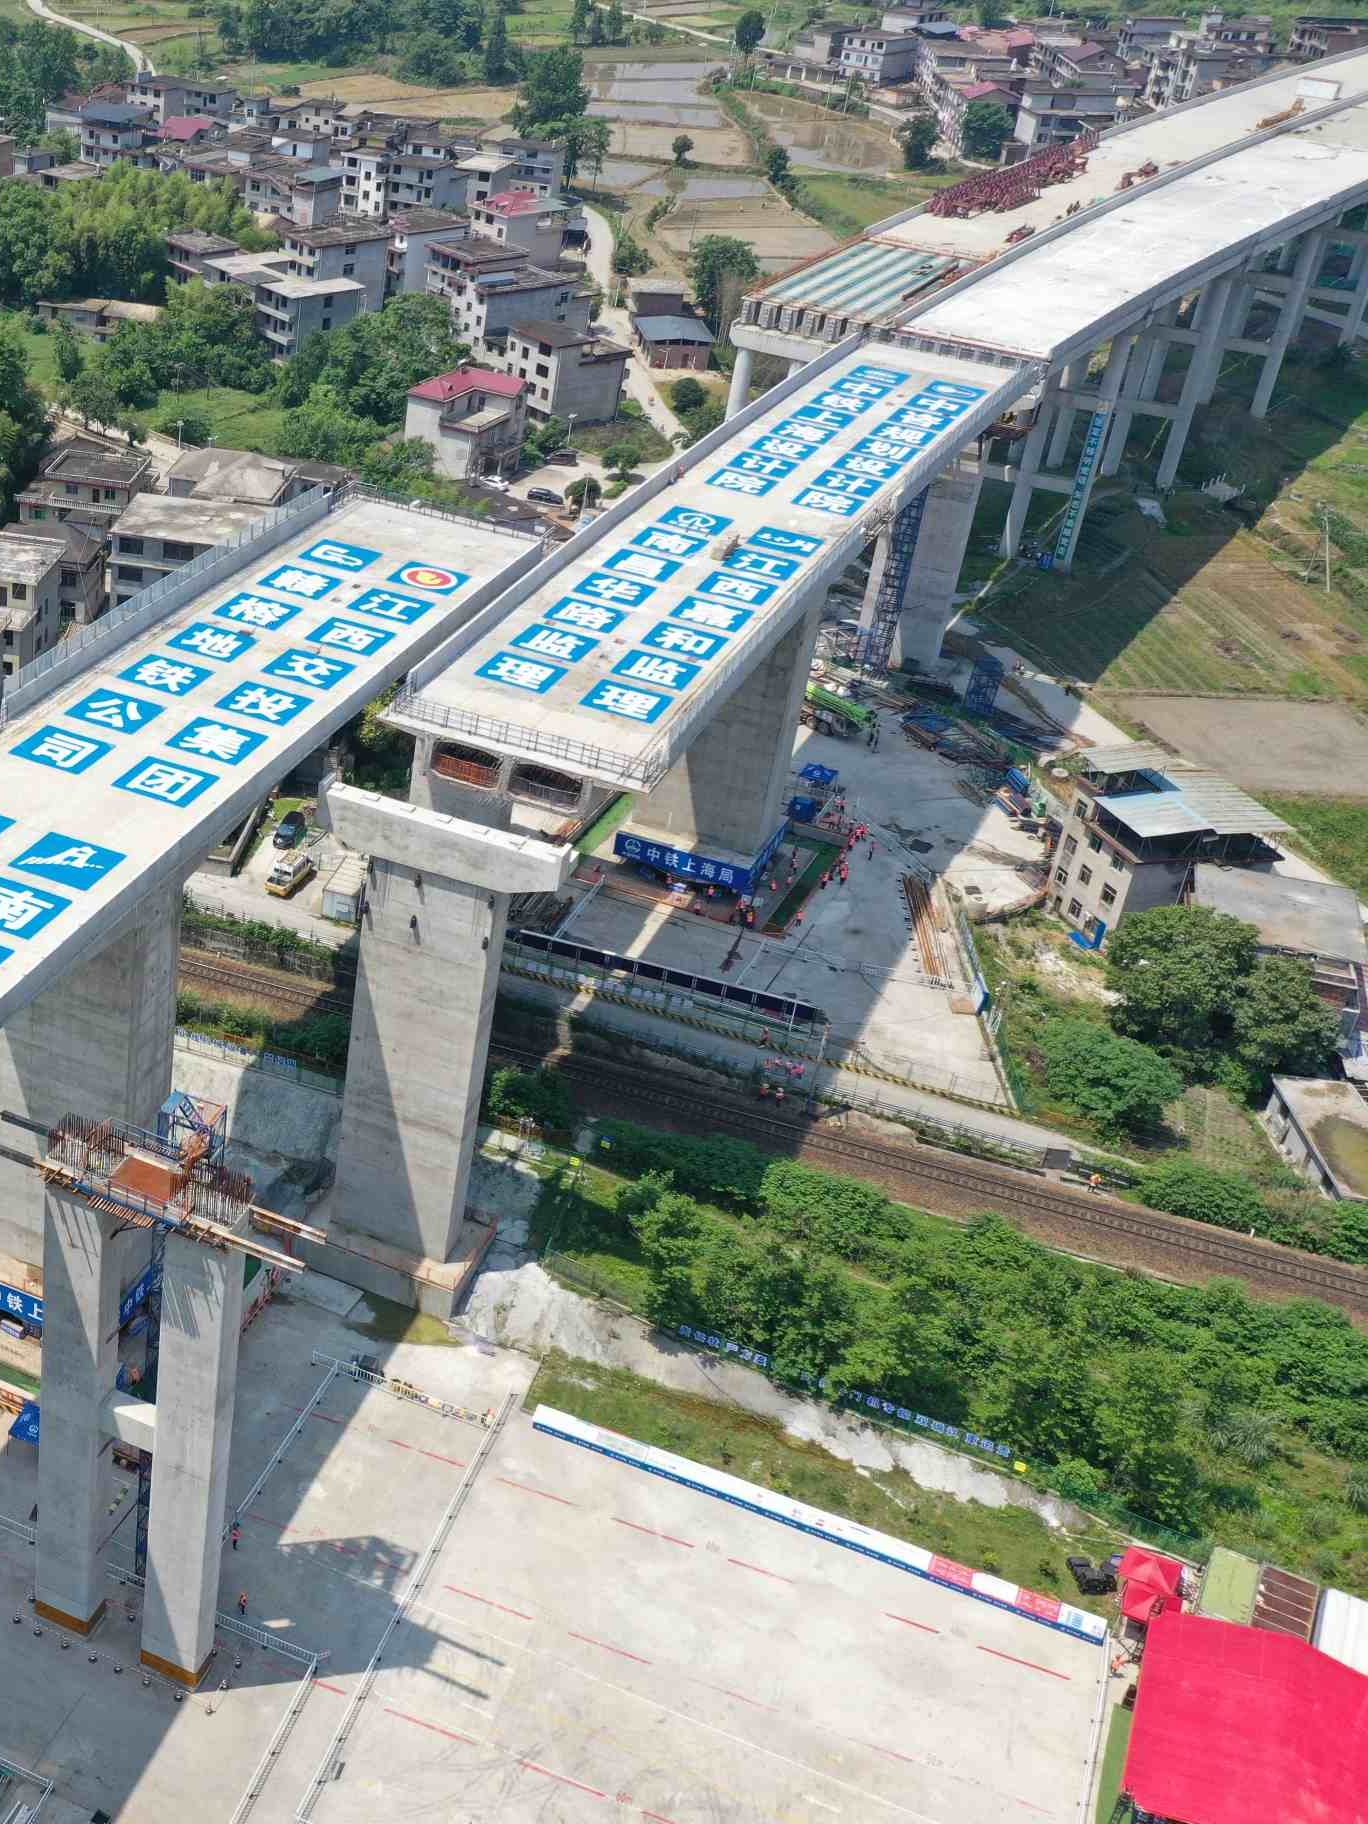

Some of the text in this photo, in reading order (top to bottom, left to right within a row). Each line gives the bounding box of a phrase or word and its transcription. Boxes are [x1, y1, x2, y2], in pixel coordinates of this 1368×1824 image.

[126, 592, 422, 801] 江西交投集团
[646, 847, 734, 884] 中铁上海局
